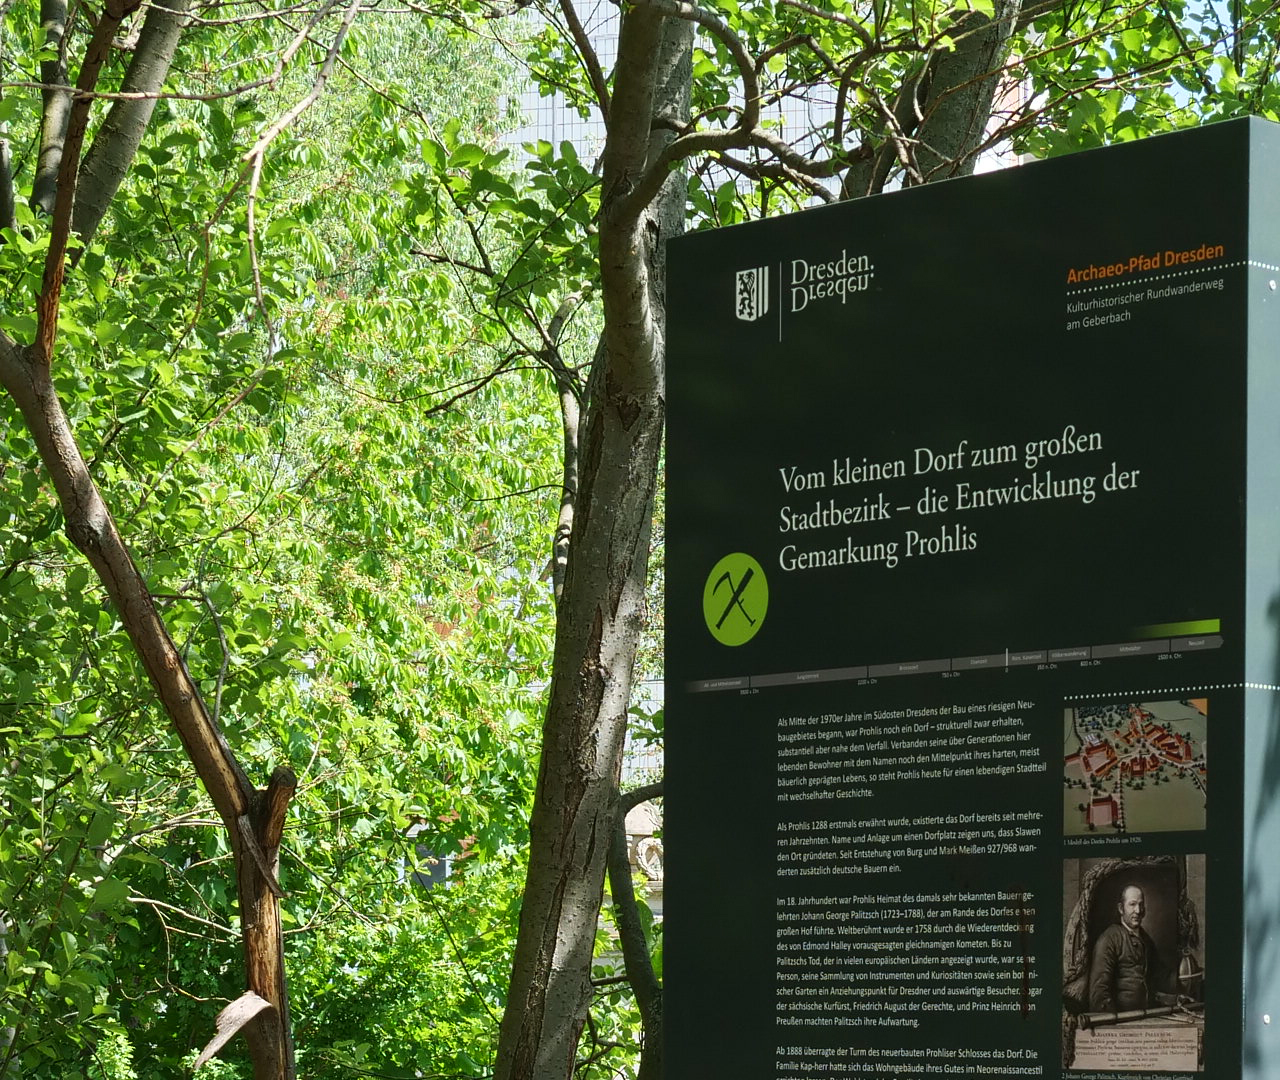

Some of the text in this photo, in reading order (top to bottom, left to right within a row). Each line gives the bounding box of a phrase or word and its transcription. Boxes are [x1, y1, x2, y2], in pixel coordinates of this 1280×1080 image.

[791, 249, 875, 285] Dresden.
[1067, 244, 1223, 284] Archaeo-Pfad Dresden
[1067, 279, 1224, 313] Kulturhistorischer Rundwanderweg
[1066, 310, 1131, 330] am Geberbach
[779, 425, 1103, 492] Vom kleinen Dorf zum großen
[779, 493, 891, 533] Stadtbezirk
[917, 487, 949, 516] die
[956, 469, 1096, 511] Entwicklung
[1103, 462, 1140, 491] der
[779, 523, 977, 571] Gemarkung Prohlis
[776, 717, 788, 726] Als
[788, 716, 806, 726] Mitte
[806, 715, 819, 724] der
[819, 713, 843, 724] 1970er
[843, 712, 862, 722] Jahre
[863, 711, 872, 720] im
[872, 709, 905, 720] Südosten
[905, 706, 938, 717] Dresdens
[938, 705, 951, 715] der
[952, 704, 966, 714] Bau
[966, 703, 986, 713] eines
[987, 701, 1016, 712] riesigen
[776, 788, 874, 801] mit wechselhafter Geschichte.
[776, 822, 787, 831] Als
[787, 821, 810, 830] Prohlis
[811, 820, 828, 830] 1288
[828, 818, 857, 829] erstmals
[857, 817, 886, 828] erwähnt
[886, 816, 911, 826] wurde,
[911, 815, 944, 825] existierte
[944, 814, 958, 823] das
[958, 812, 975, 823] Dorf
[975, 812, 1001, 822] bereits
[1001, 811, 1015, 821] seit
[776, 852, 790, 861] den
[790, 851, 802, 861] Ort
[802, 850, 838, 862] gründeten.
[839, 849, 853, 859] Seit
[853, 848, 892, 859] Entstehung
[891, 849, 905, 857] von
[905, 847, 923, 858] Burg
[923, 845, 938, 856] und
[938, 845, 957, 855] Mark
[958, 844, 986, 854] Meißen
[986, 842, 1018, 854] 927/968
[775, 941, 788, 950] des
[801, 940, 830, 950] Edmond
[830, 940, 851, 951] Halley
[851, 941, 904, 951] vorausgesagten
[904, 939, 955, 951] gleichnamigen
[955, 939, 990, 948] Kometen.
[990, 938, 1002, 948] Bis
[775, 1045, 1038, 1059] Ab 1888 überragte der Turm des neuerbauten Prohliser Schlosses das Dorf. Die
